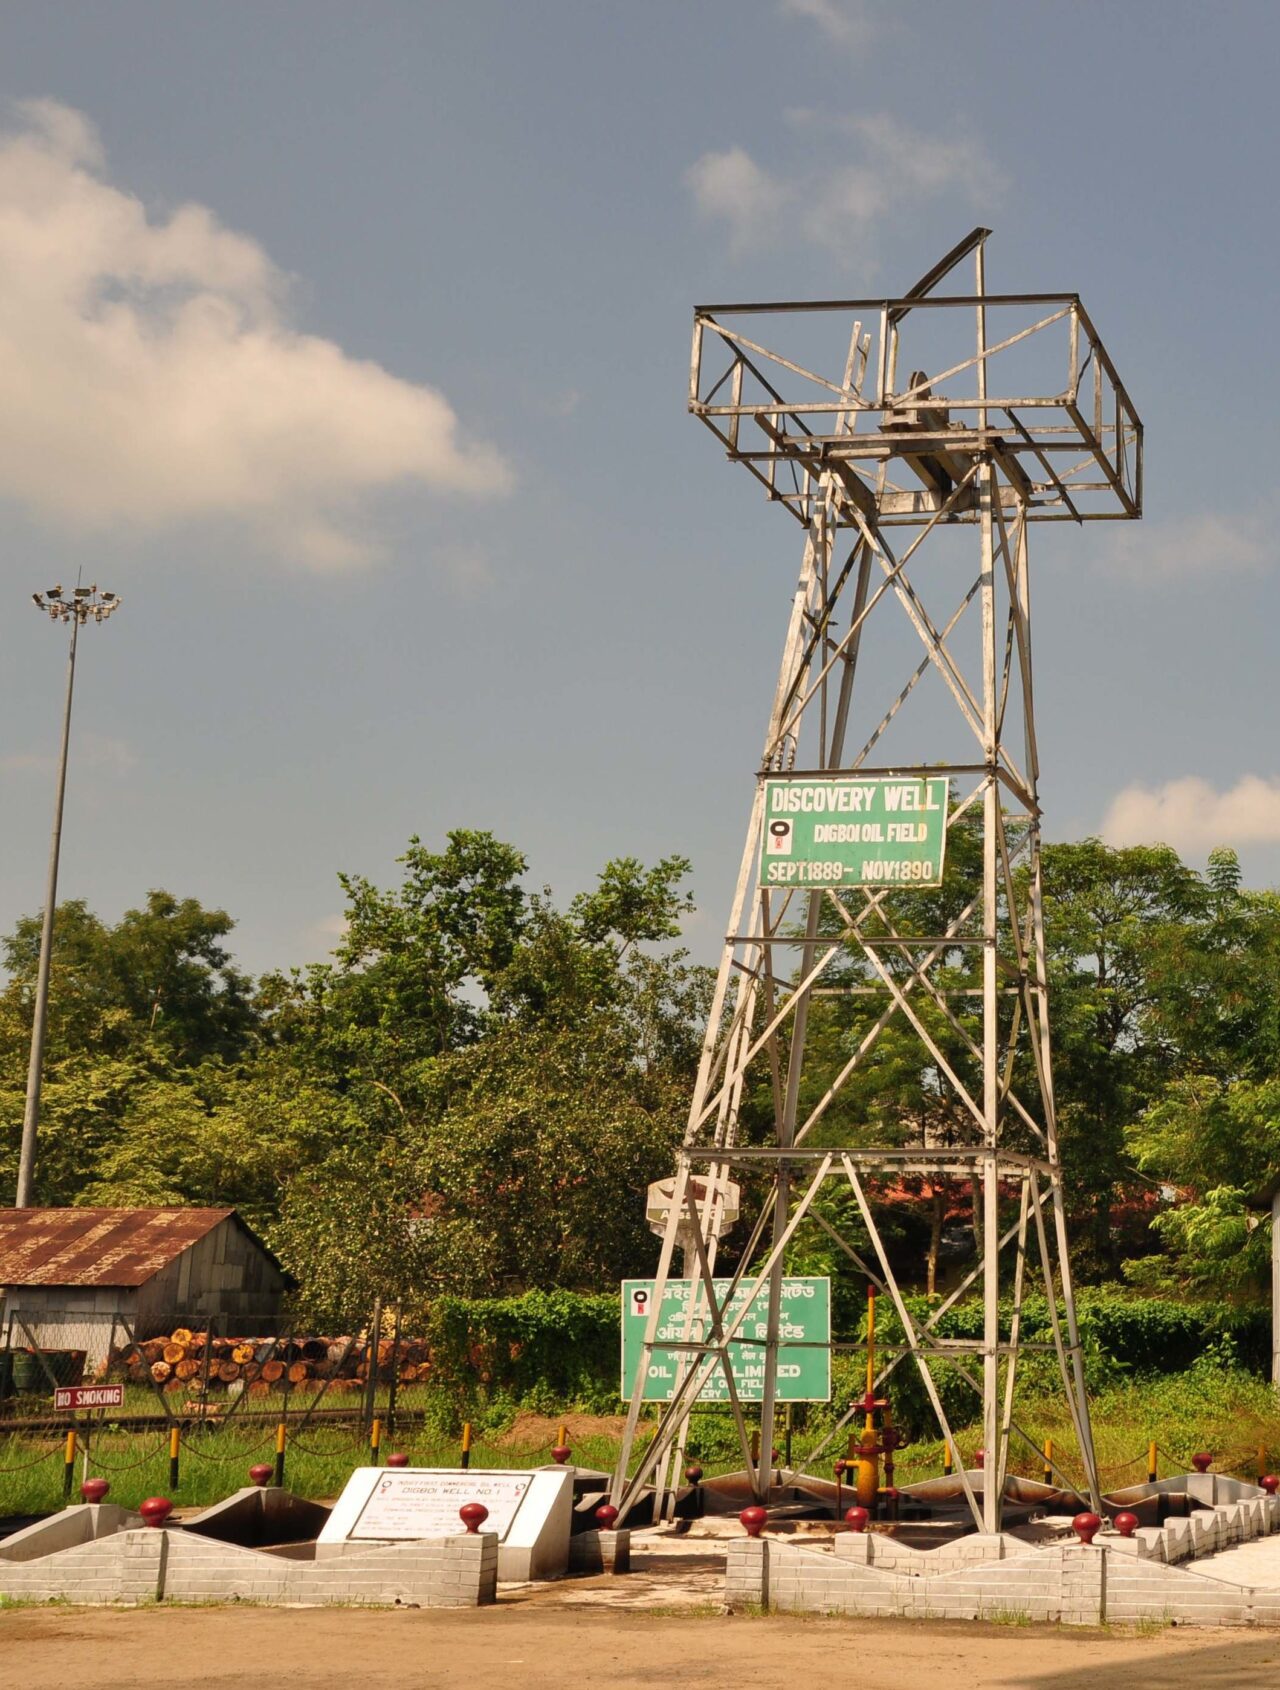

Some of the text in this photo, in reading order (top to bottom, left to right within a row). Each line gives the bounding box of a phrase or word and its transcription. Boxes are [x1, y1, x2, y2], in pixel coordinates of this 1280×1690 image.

[772, 785, 940, 812] DISCOVERY WELL
[814, 823, 928, 843] DIGBOI OIL FIELD
[648, 1365, 673, 1378] OIL
[732, 1364, 801, 1378] LIMIED
[741, 1379, 766, 1388] FIEL
[57, 1388, 120, 1407] NO SMOKING
[730, 1389, 755, 1398] ELL
[442, 1487, 470, 1495] WELL
